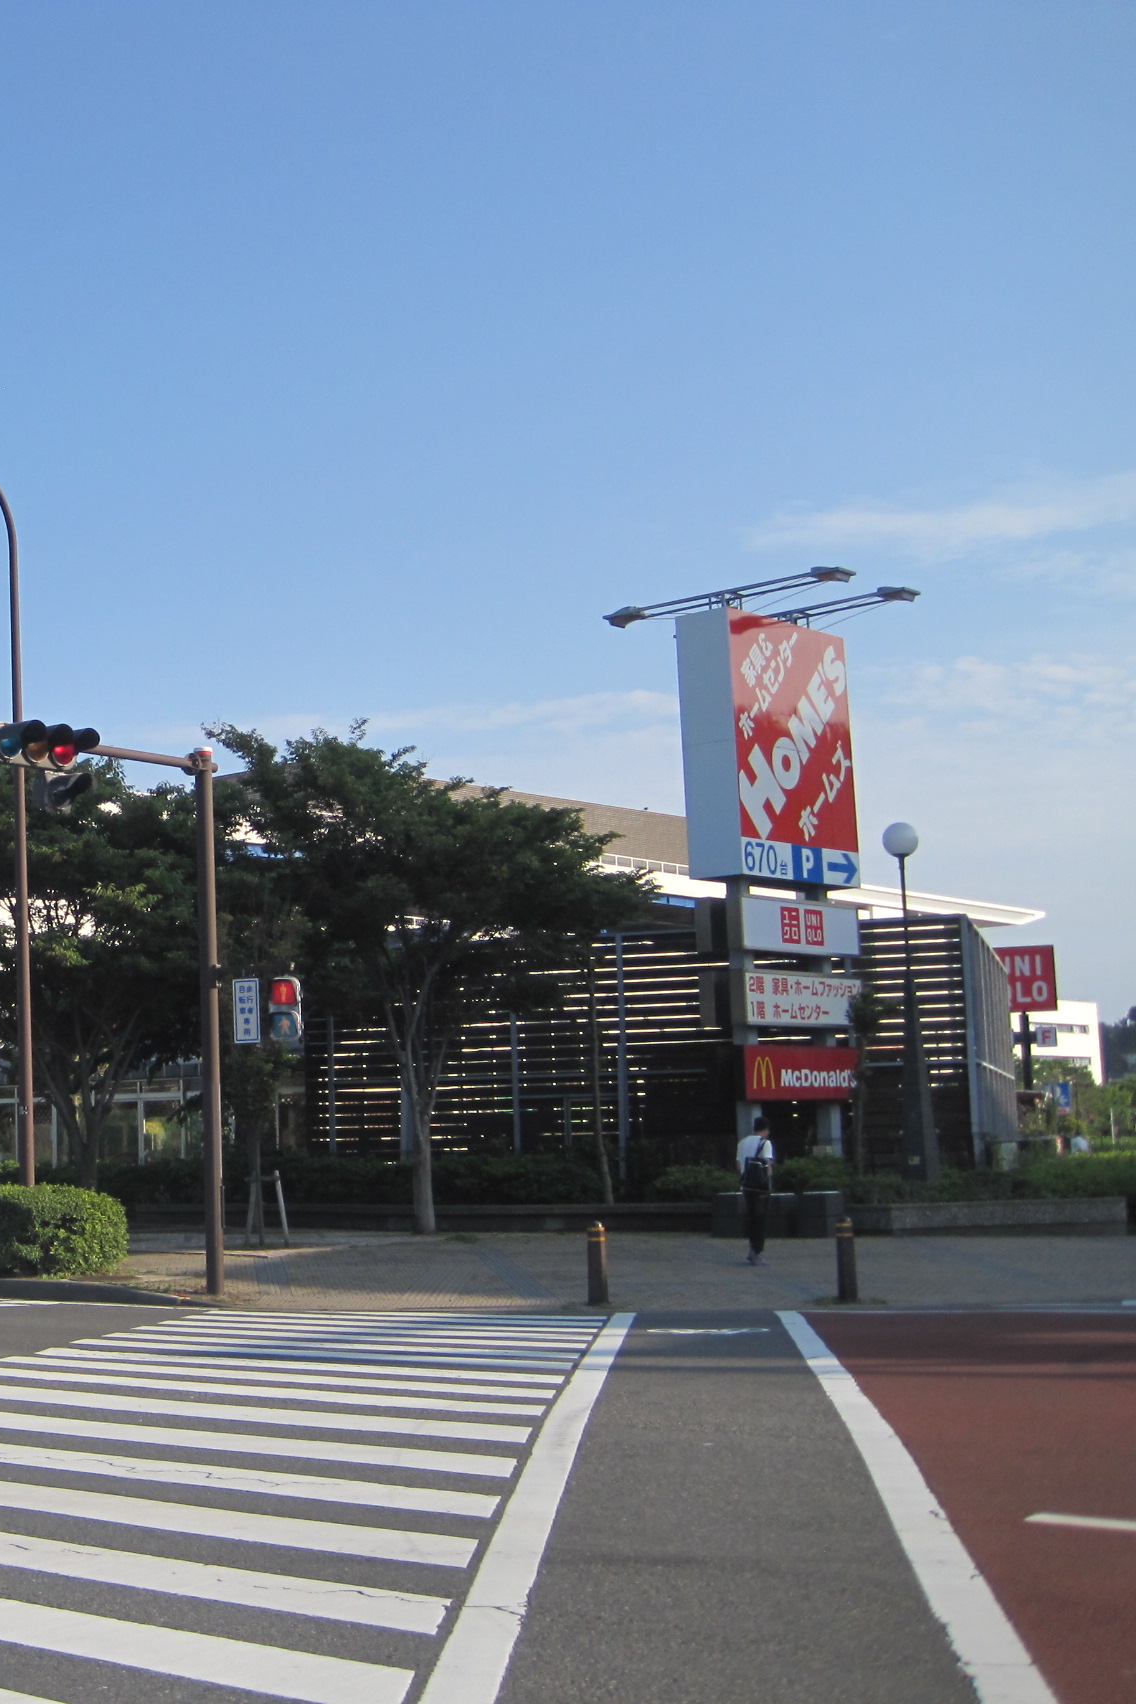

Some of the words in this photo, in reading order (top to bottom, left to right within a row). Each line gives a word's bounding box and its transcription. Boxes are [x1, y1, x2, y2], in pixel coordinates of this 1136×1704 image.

[738, 631, 798, 740] ホームセンター
[738, 645, 847, 841] HOME'S
[798, 740, 852, 842] ホームズ
[801, 848, 815, 879] P
[805, 913, 821, 927] UNI
[806, 929, 822, 943] QLO
[748, 976, 765, 995] 2階
[1007, 980, 1049, 1006] LO
[750, 1001, 766, 1020] 1階
[772, 1002, 830, 1020] ホームセンター
[780, 1068, 857, 1088] McDonald's
